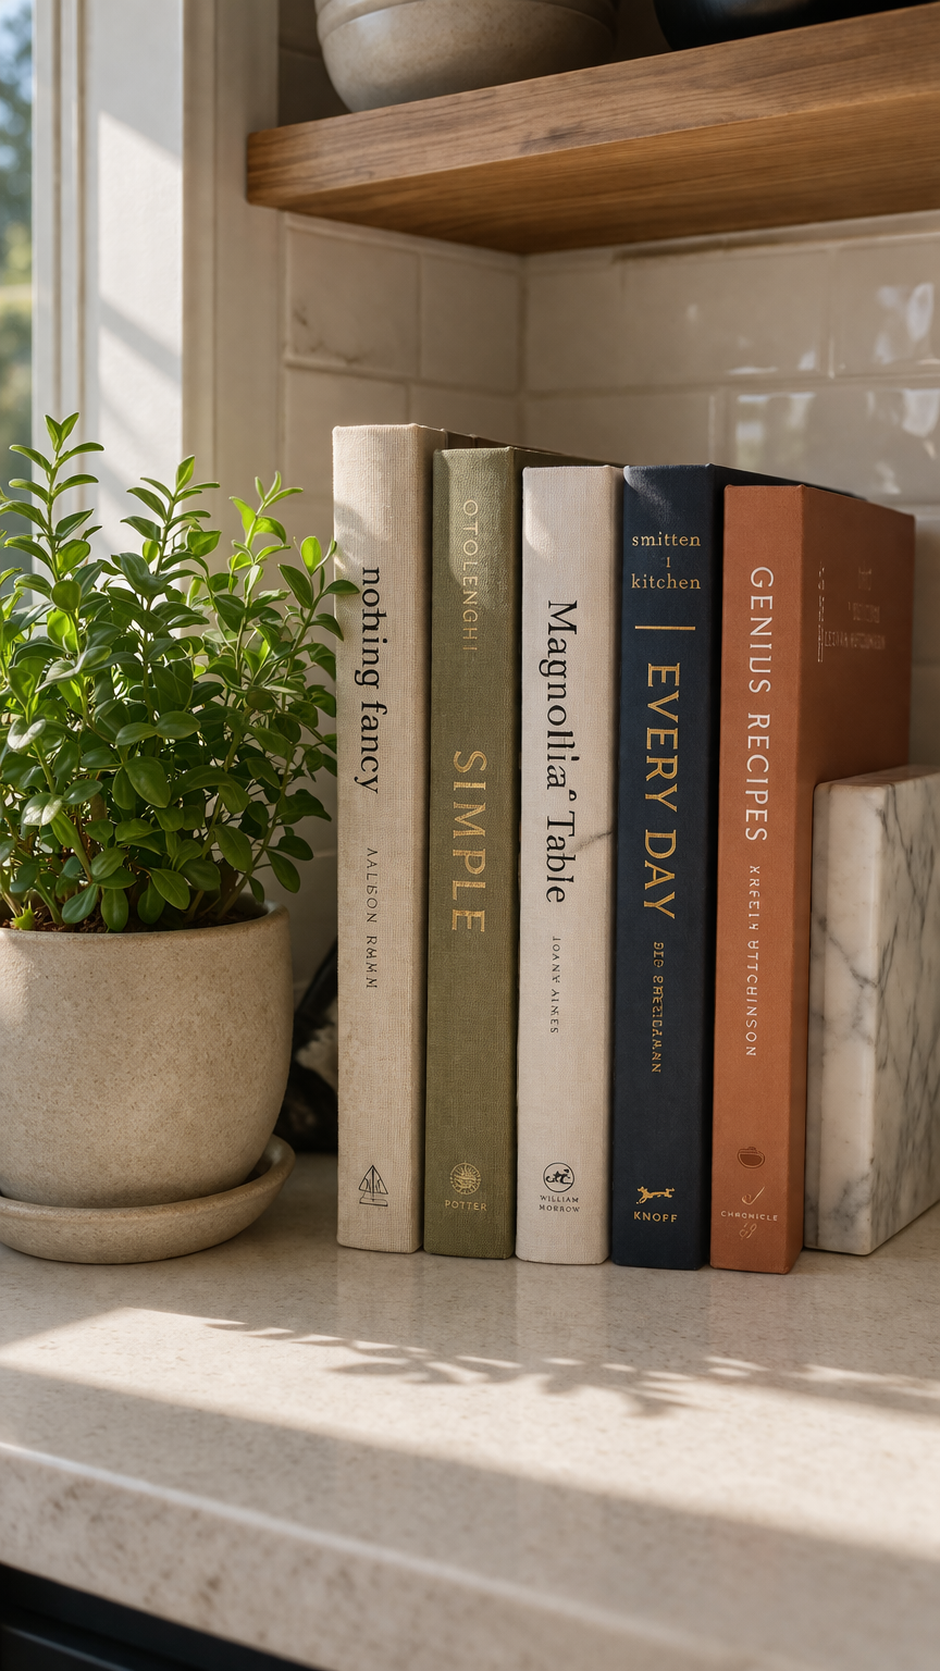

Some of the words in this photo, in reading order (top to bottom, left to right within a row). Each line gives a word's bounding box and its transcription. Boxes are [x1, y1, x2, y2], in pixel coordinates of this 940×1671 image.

[462, 500, 478, 651] OTOLENGHI
[631, 573, 701, 590] kitchen
[632, 531, 701, 547] smitten
[749, 566, 774, 693] GENIUS
[354, 701, 387, 793] fancy
[645, 662, 680, 812] EVERY
[745, 713, 770, 841] RECIPES
[452, 751, 487, 932] SIMPLE
[546, 811, 576, 902] Table
[644, 829, 677, 919] DAY
[444, 1199, 487, 1212] POTTER
[539, 1204, 580, 1213] MORROW
[540, 1194, 579, 1203] WILLIAM
[633, 1211, 678, 1223] KNOPF
[720, 1210, 778, 1222] CHRONICLE
